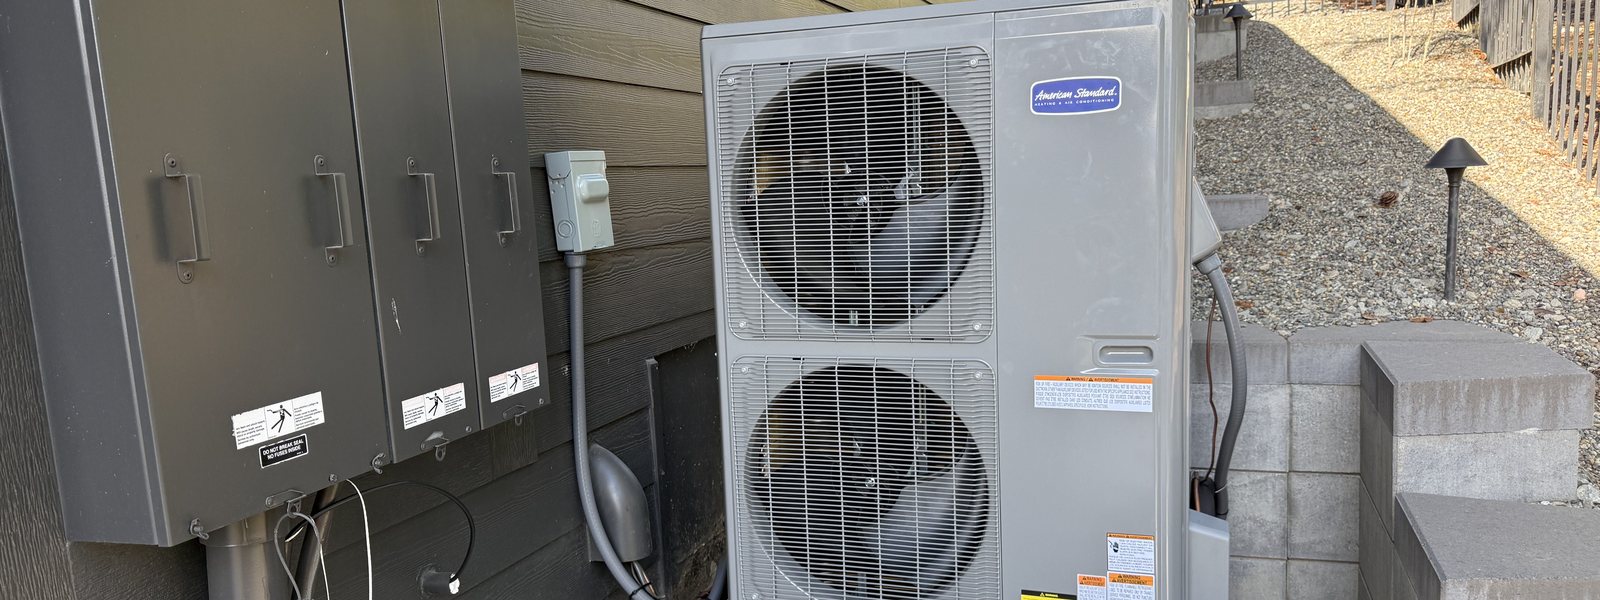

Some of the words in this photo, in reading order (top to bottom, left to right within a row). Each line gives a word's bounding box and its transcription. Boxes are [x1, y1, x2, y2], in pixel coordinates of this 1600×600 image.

[1034, 89, 1073, 101] American
[274, 449, 288, 457] FUSES
[288, 445, 301, 453] INSIDE
[279, 442, 293, 450] BREAK
